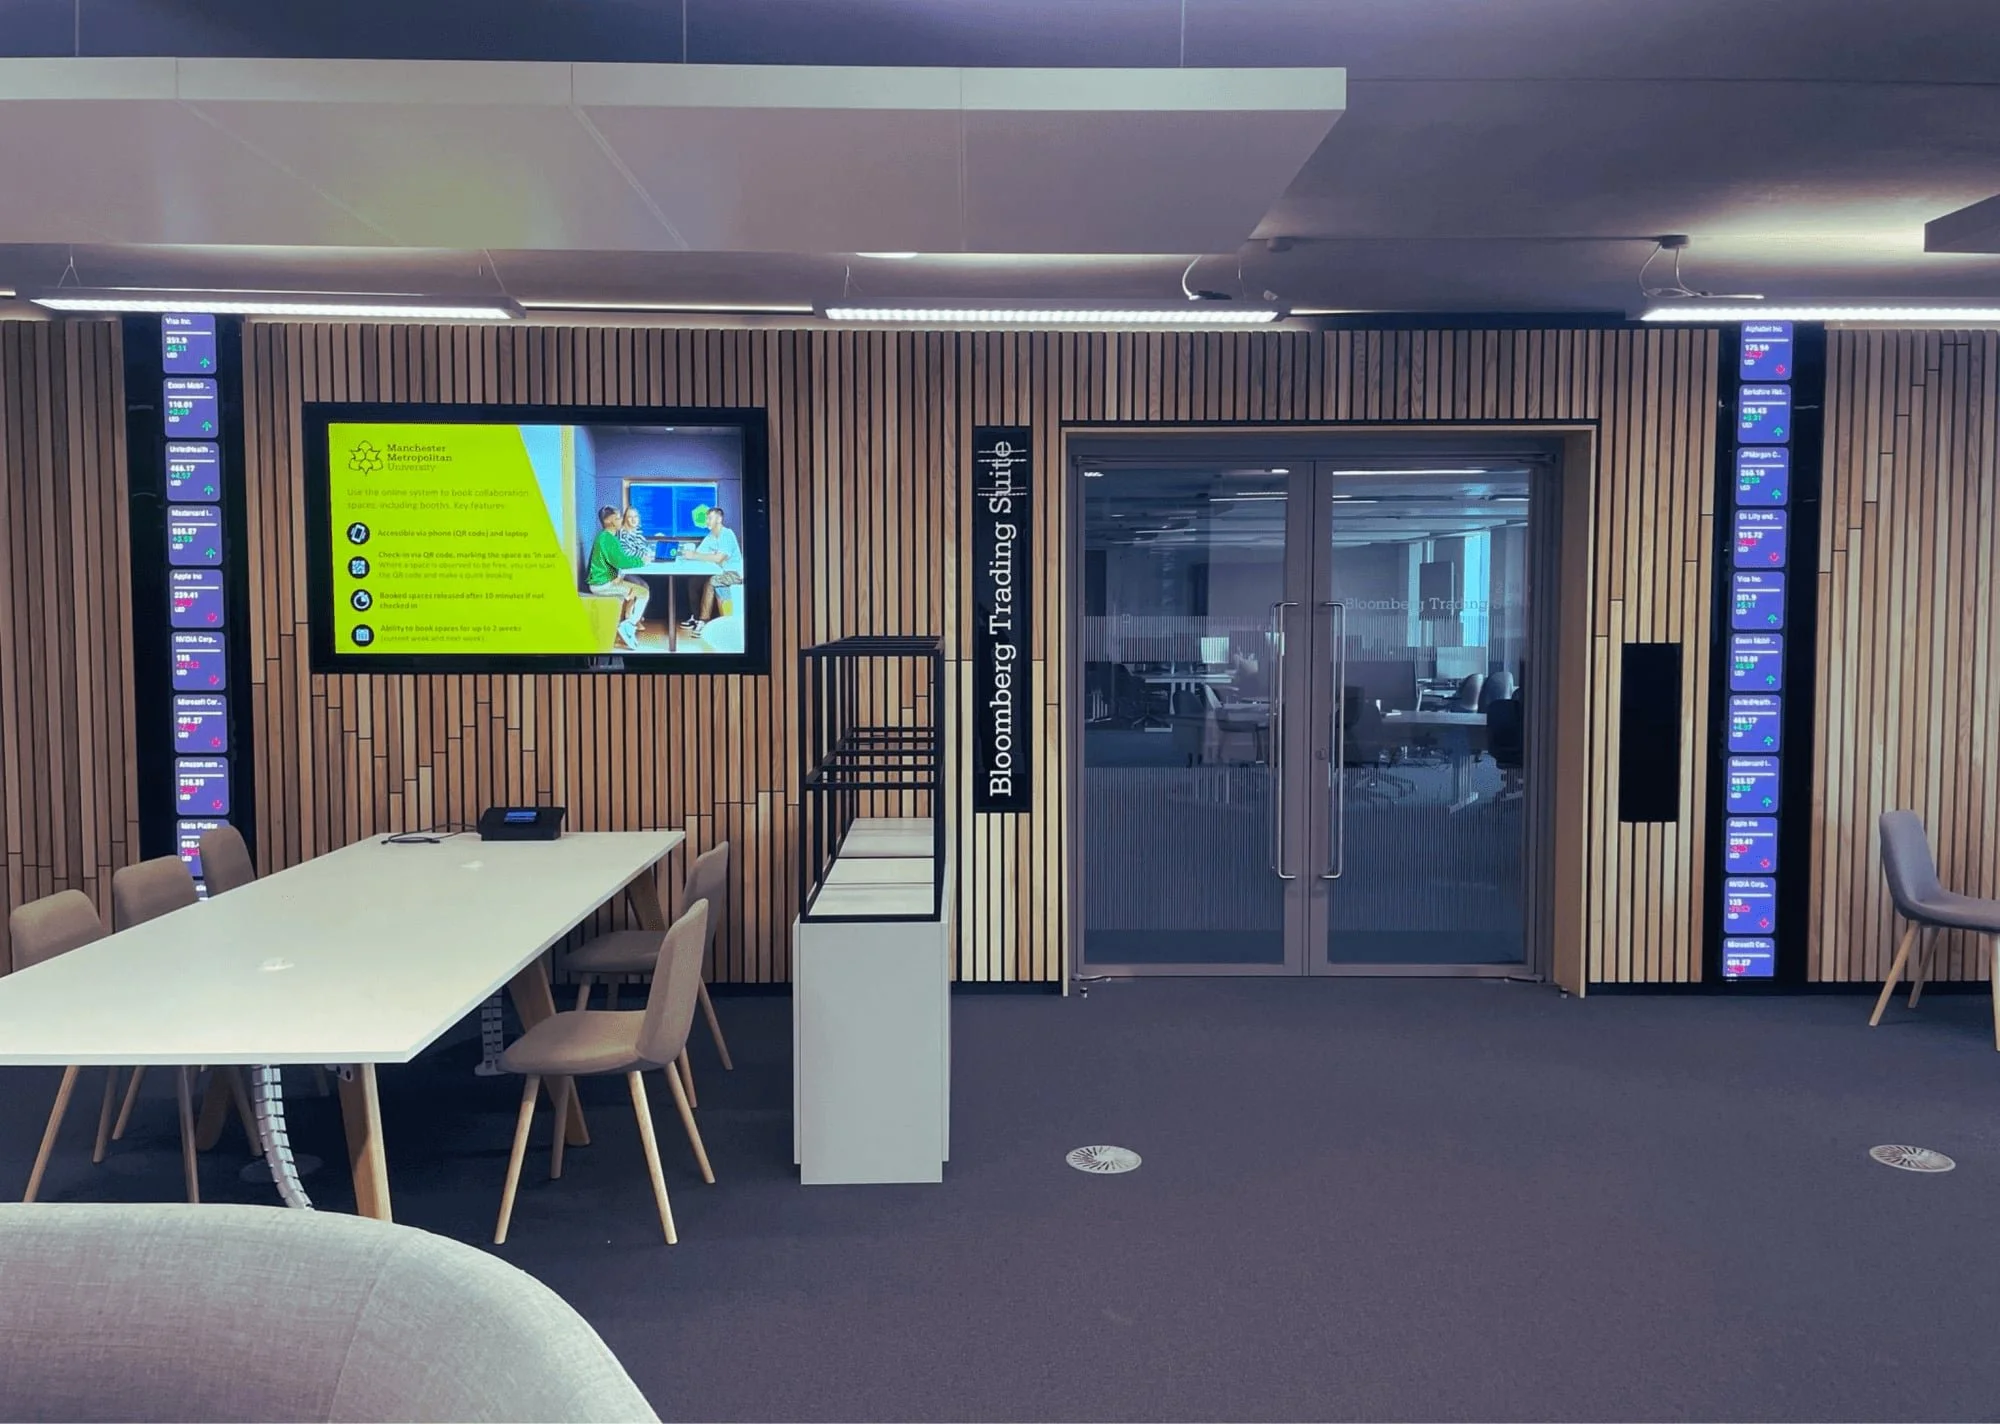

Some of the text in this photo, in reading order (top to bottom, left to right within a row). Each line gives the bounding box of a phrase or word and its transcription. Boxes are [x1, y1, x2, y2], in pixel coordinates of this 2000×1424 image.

[1743, 388, 1770, 396] Berkshire
[387, 444, 446, 452] Manchester
[387, 454, 452, 462] Metropolitan
[1741, 452, 1771, 460] JPMorgan
[387, 464, 436, 472] University
[347, 488, 362, 496] Use
[365, 488, 379, 496] the
[381, 488, 407, 496] online
[409, 489, 438, 498] system
[452, 488, 472, 496] book
[474, 488, 528, 496] collaboration
[428, 530, 451, 538] phone
[505, 530, 528, 538] laptop
[174, 572, 192, 580] Apple
[1344, 597, 1424, 613] Bloombeg
[989, 441, 1017, 797] Bloomberg Trading Suite
[178, 698, 206, 706] Microsoft
